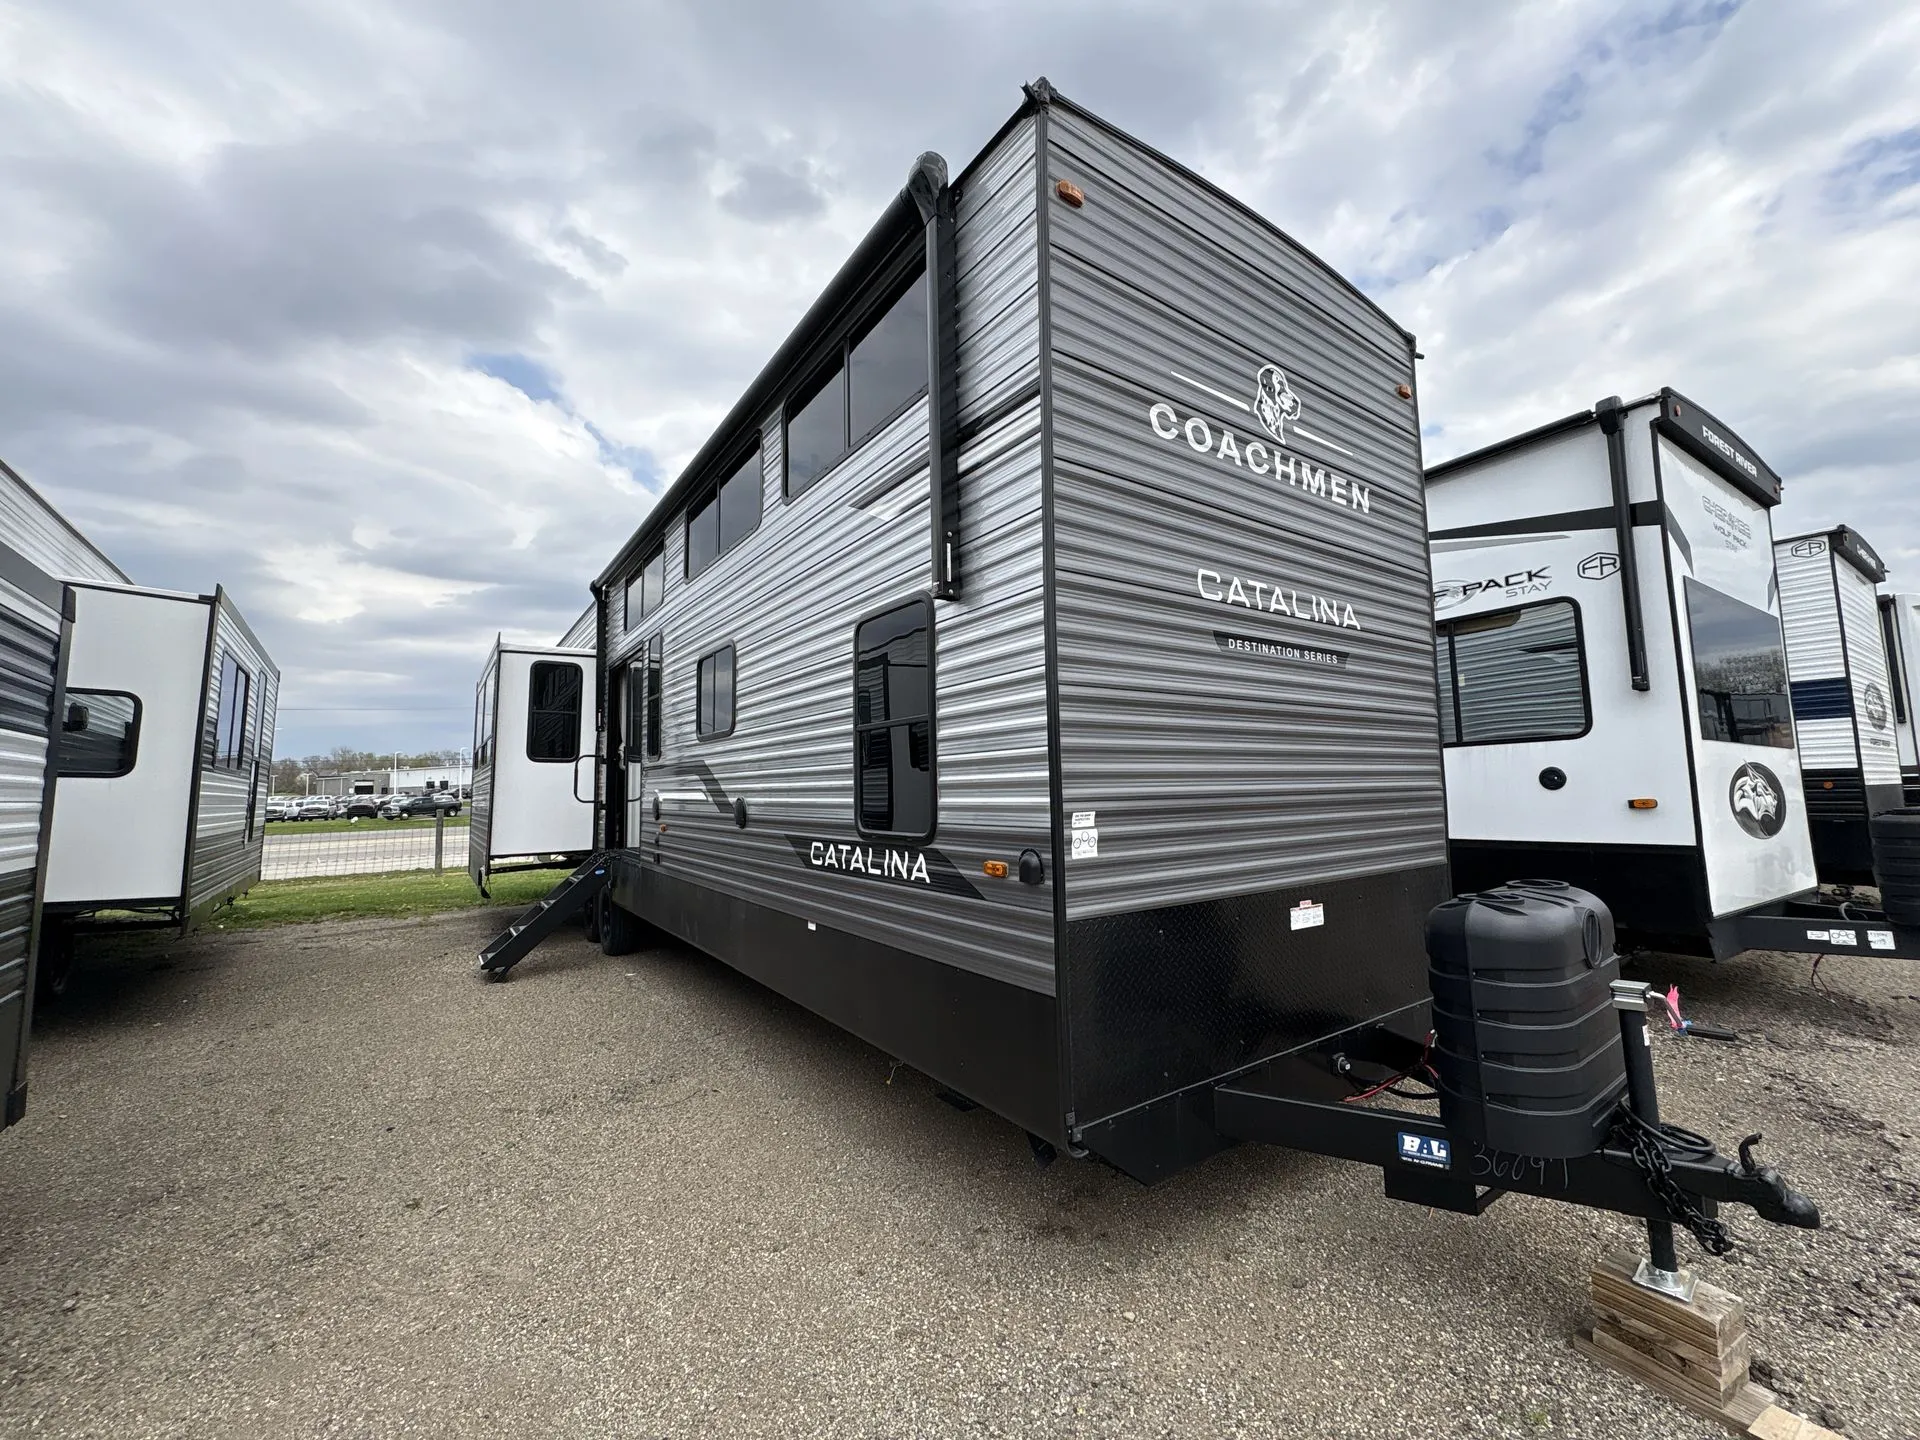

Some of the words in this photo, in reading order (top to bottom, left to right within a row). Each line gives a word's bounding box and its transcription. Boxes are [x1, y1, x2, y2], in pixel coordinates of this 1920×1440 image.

[1149, 403, 1370, 513] COACHMEN
[1702, 424, 1735, 459] FOREST
[1735, 452, 1757, 478] RIVER
[1197, 568, 1361, 630] CATALINA
[1462, 565, 1552, 596] PACK
[1506, 580, 1552, 598] STAY
[1228, 638, 1300, 659] DESTINATION
[1304, 650, 1338, 664] SERIES
[809, 841, 931, 884] CATALINA
[1402, 1135, 1447, 1158] BAL
